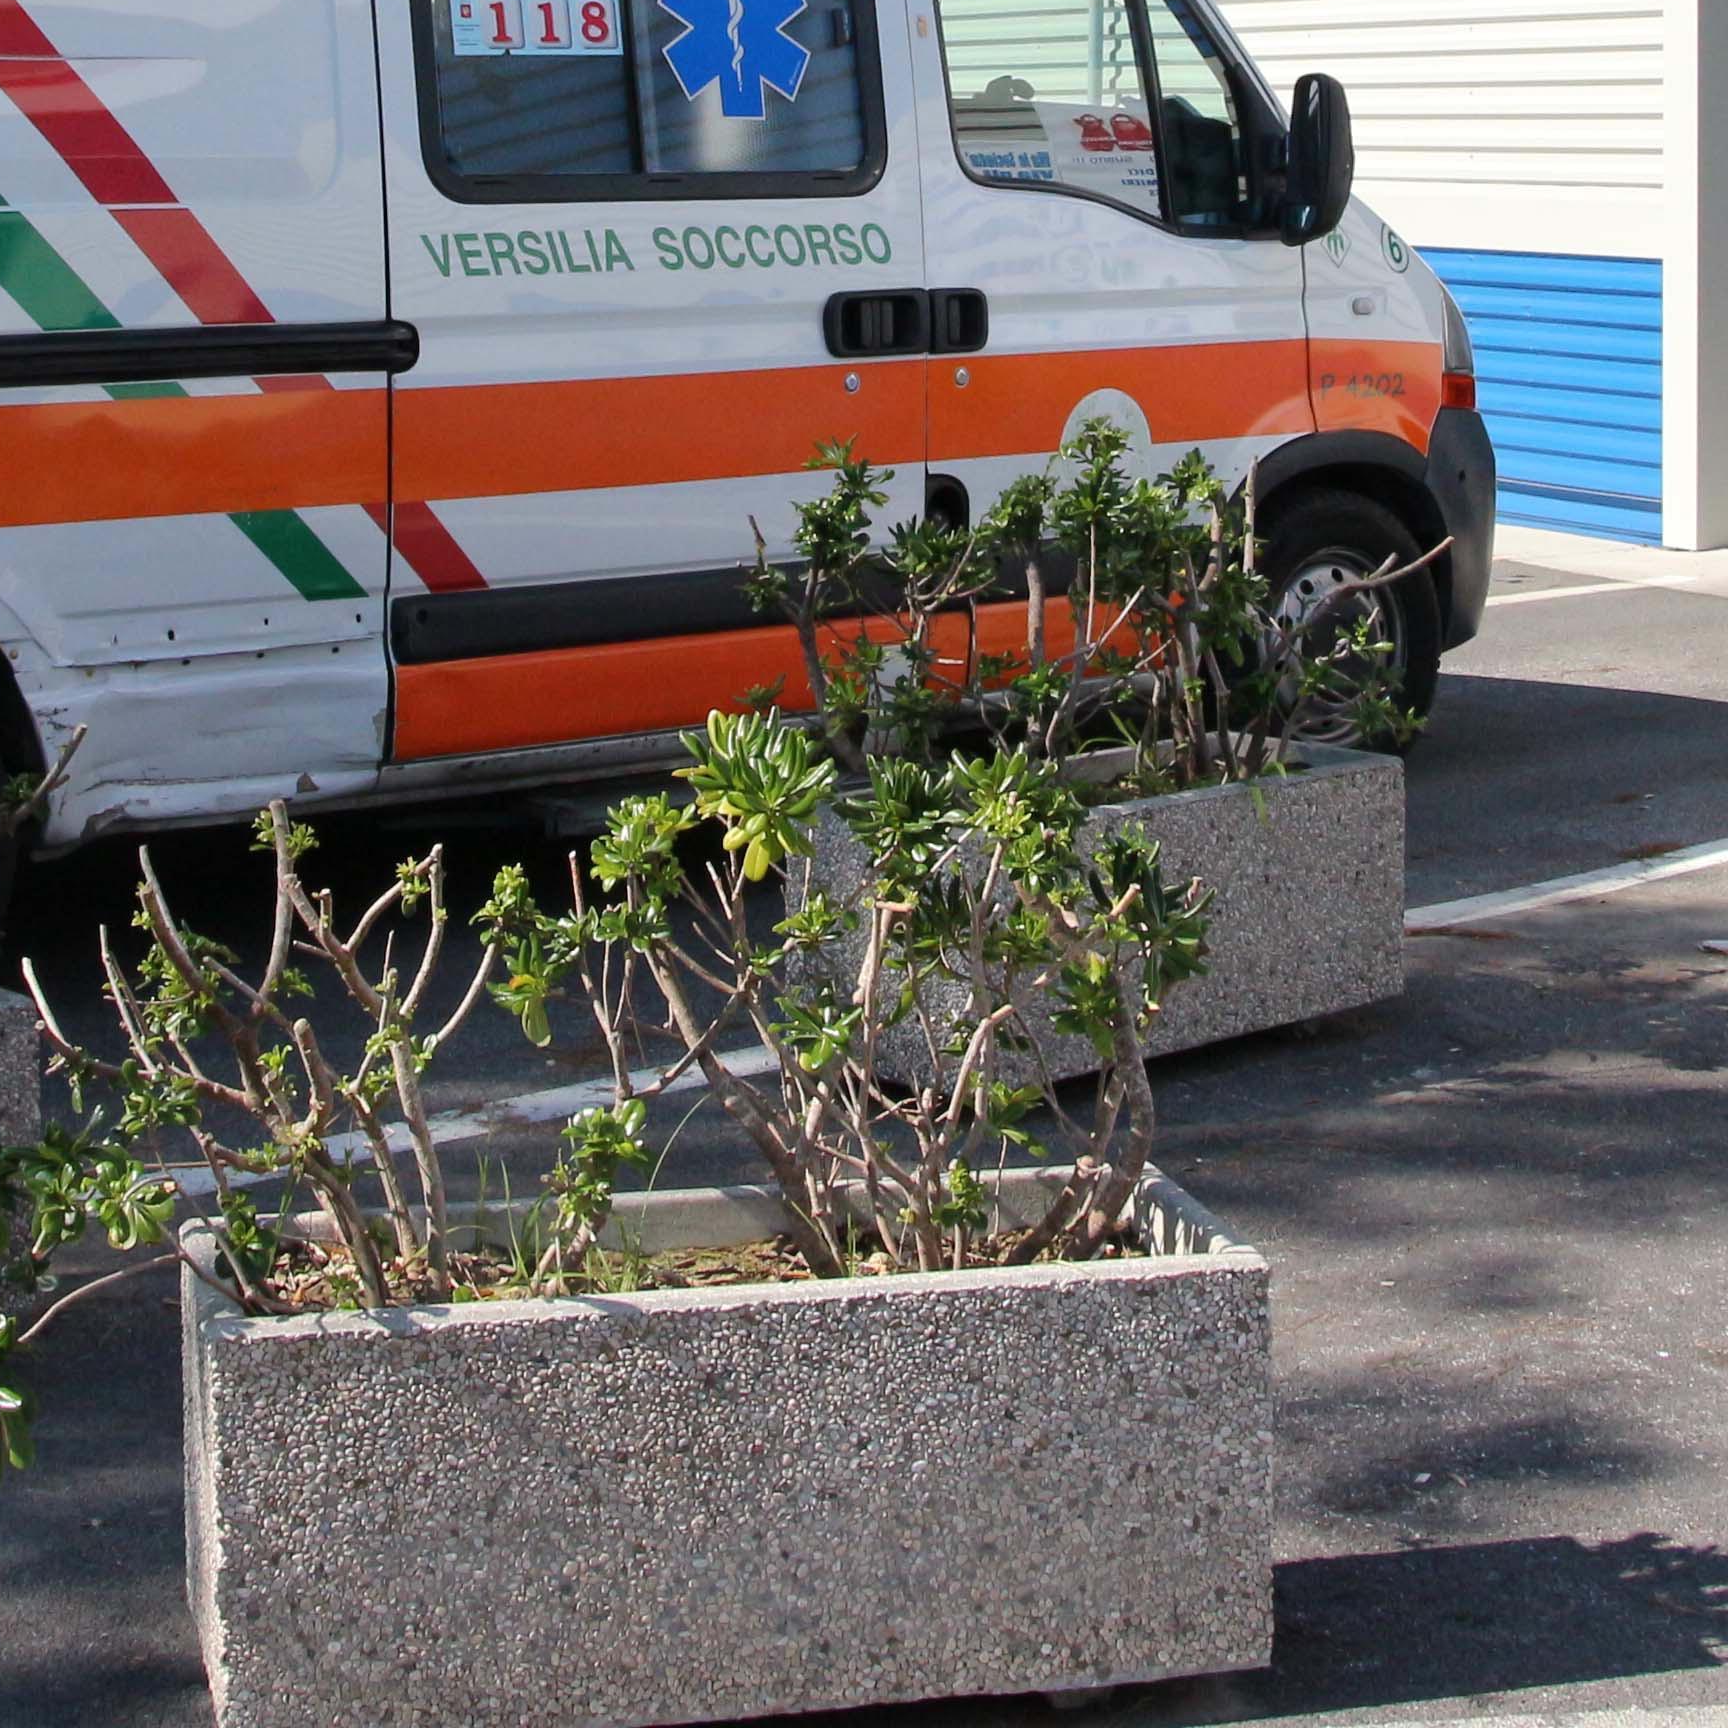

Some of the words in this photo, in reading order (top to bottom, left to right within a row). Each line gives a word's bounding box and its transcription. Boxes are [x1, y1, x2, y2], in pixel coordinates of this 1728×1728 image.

[489, 0, 610, 44] 118
[421, 227, 634, 278] VERSILIA
[652, 222, 892, 271] SOCCORSO
[1387, 231, 1402, 264] 6
[1346, 373, 1405, 400] 4202
